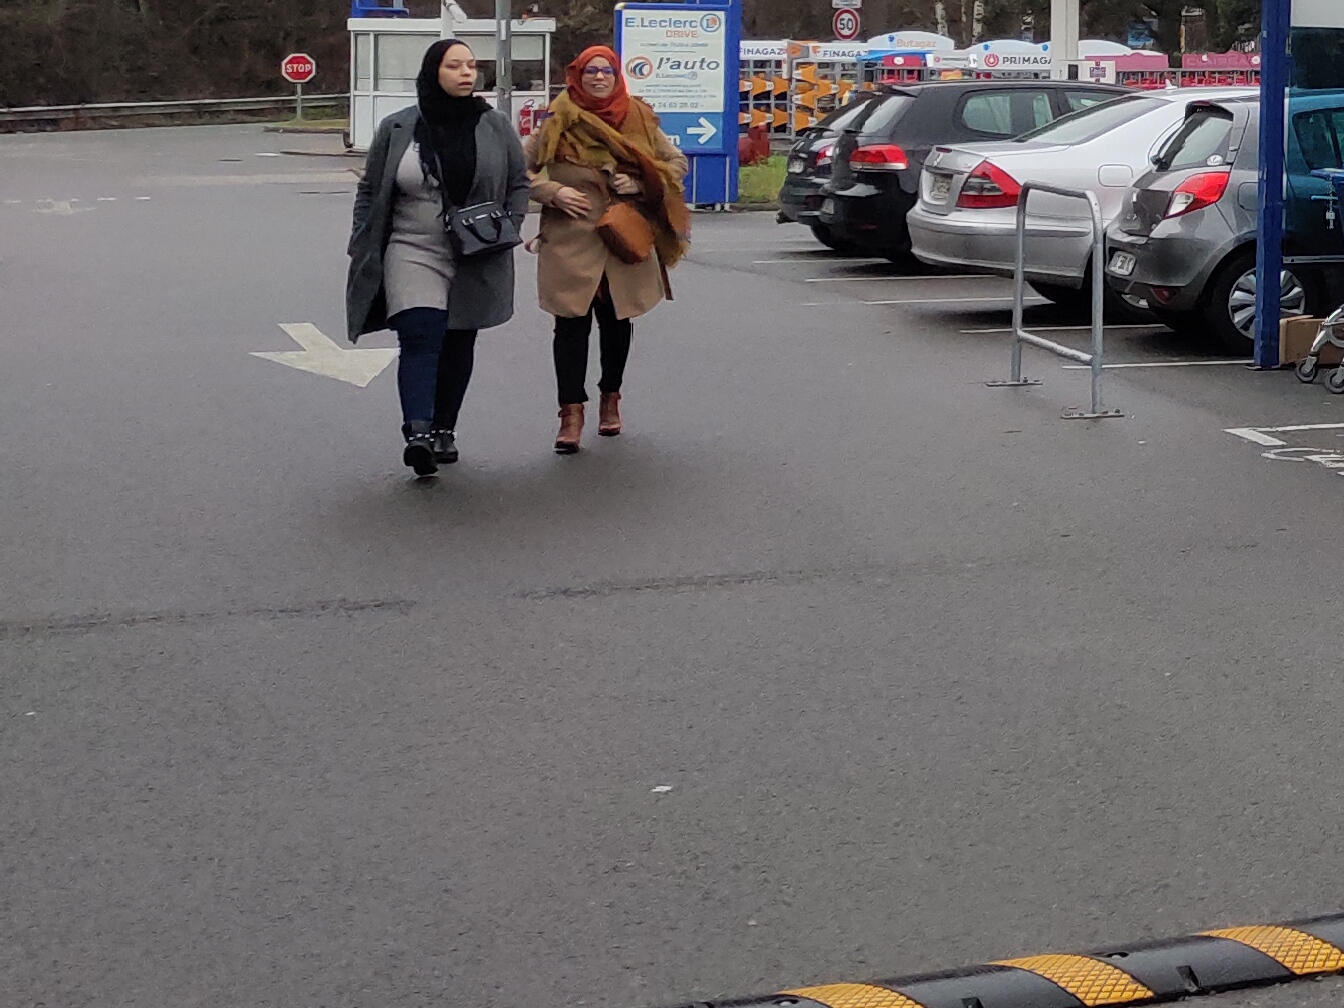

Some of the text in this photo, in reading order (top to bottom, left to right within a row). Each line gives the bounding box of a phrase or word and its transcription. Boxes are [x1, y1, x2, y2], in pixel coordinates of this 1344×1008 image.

[625, 17, 698, 28] E.Leclerc
[839, 17, 853, 31] 50
[665, 30, 698, 38] DRIVE
[1002, 56, 1051, 65] PRIMAG
[286, 63, 312, 73] STOP
